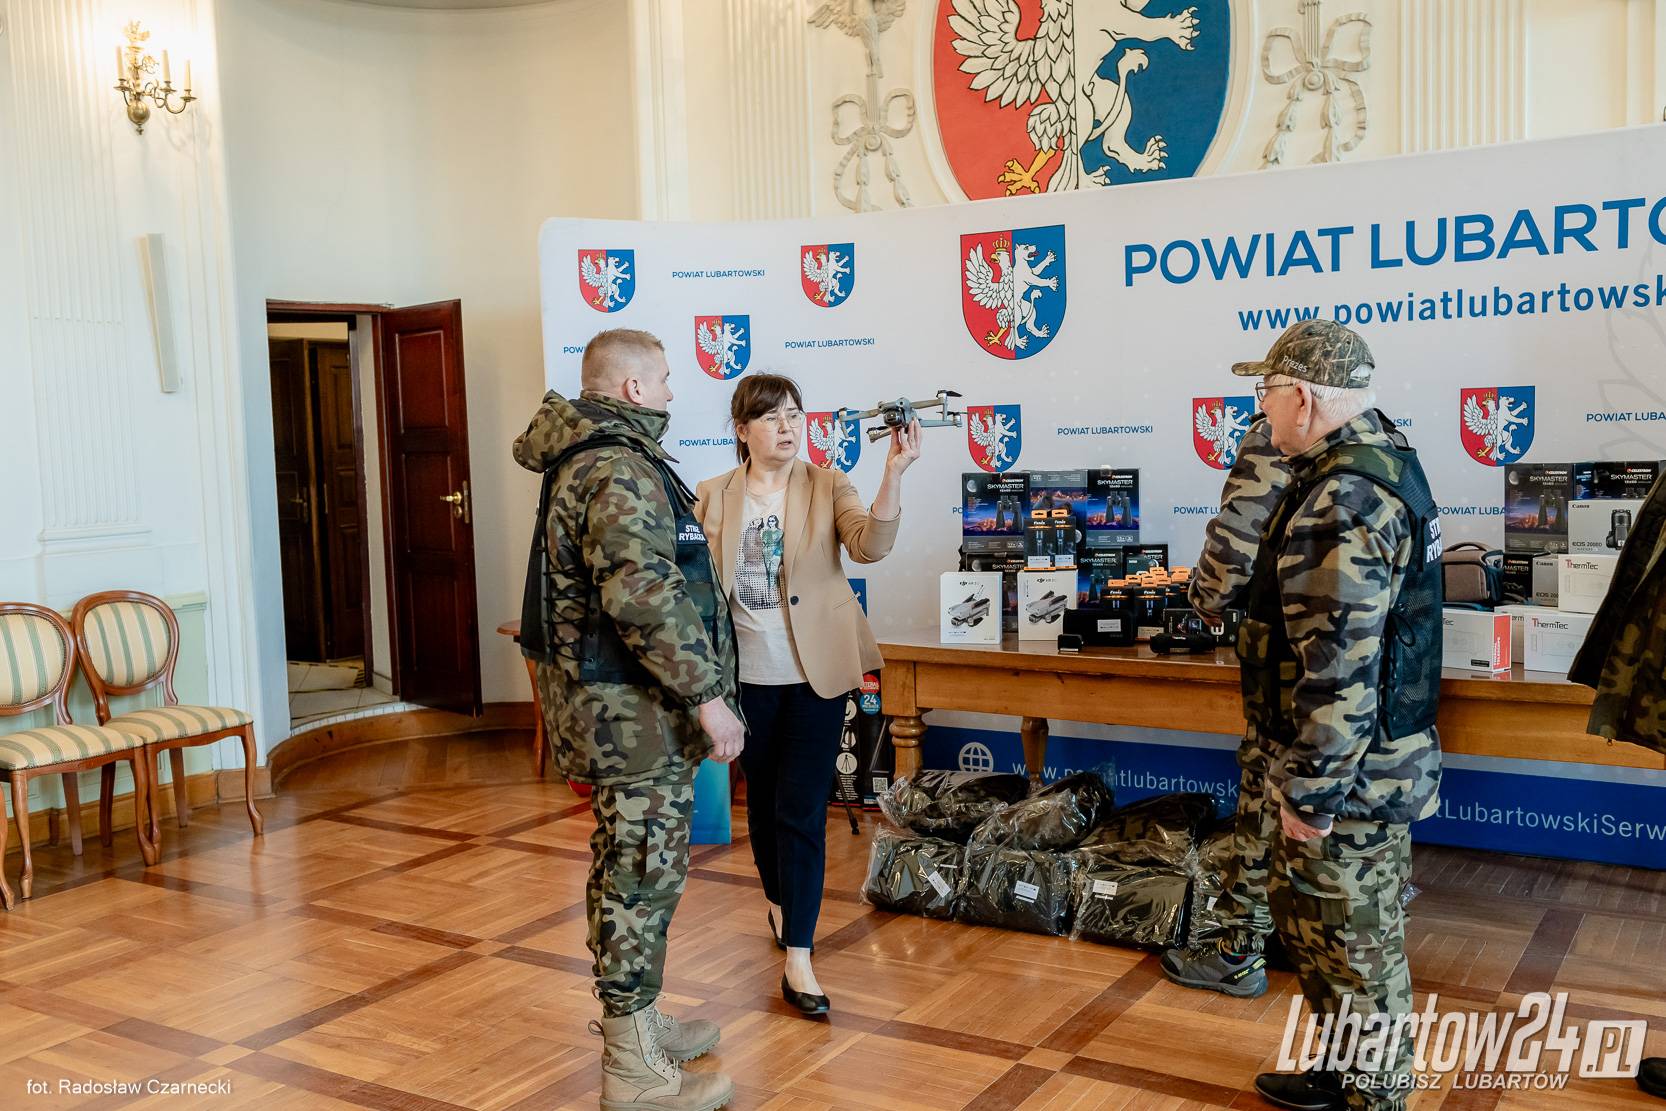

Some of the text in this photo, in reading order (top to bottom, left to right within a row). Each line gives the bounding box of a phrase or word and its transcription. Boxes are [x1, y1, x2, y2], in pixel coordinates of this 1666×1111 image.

[1124, 225, 1355, 287] POWIAT
[671, 269, 765, 279] POWIAT LUBARTOWSKI
[784, 337, 875, 349] POWIAT LUBARTOWSKI
[563, 346, 584, 354] POW
[1586, 412, 1633, 422] POWIAT
[1057, 424, 1153, 436] POWIAT LUBARTOWSKI
[679, 438, 711, 447] POWIAT
[1173, 505, 1209, 515] POWIAT
[1437, 506, 1477, 515] POWIAT
[1565, 559, 1599, 570] ThermTec
[1532, 617, 1569, 630] ThermTec
[864, 694, 877, 705] 24
